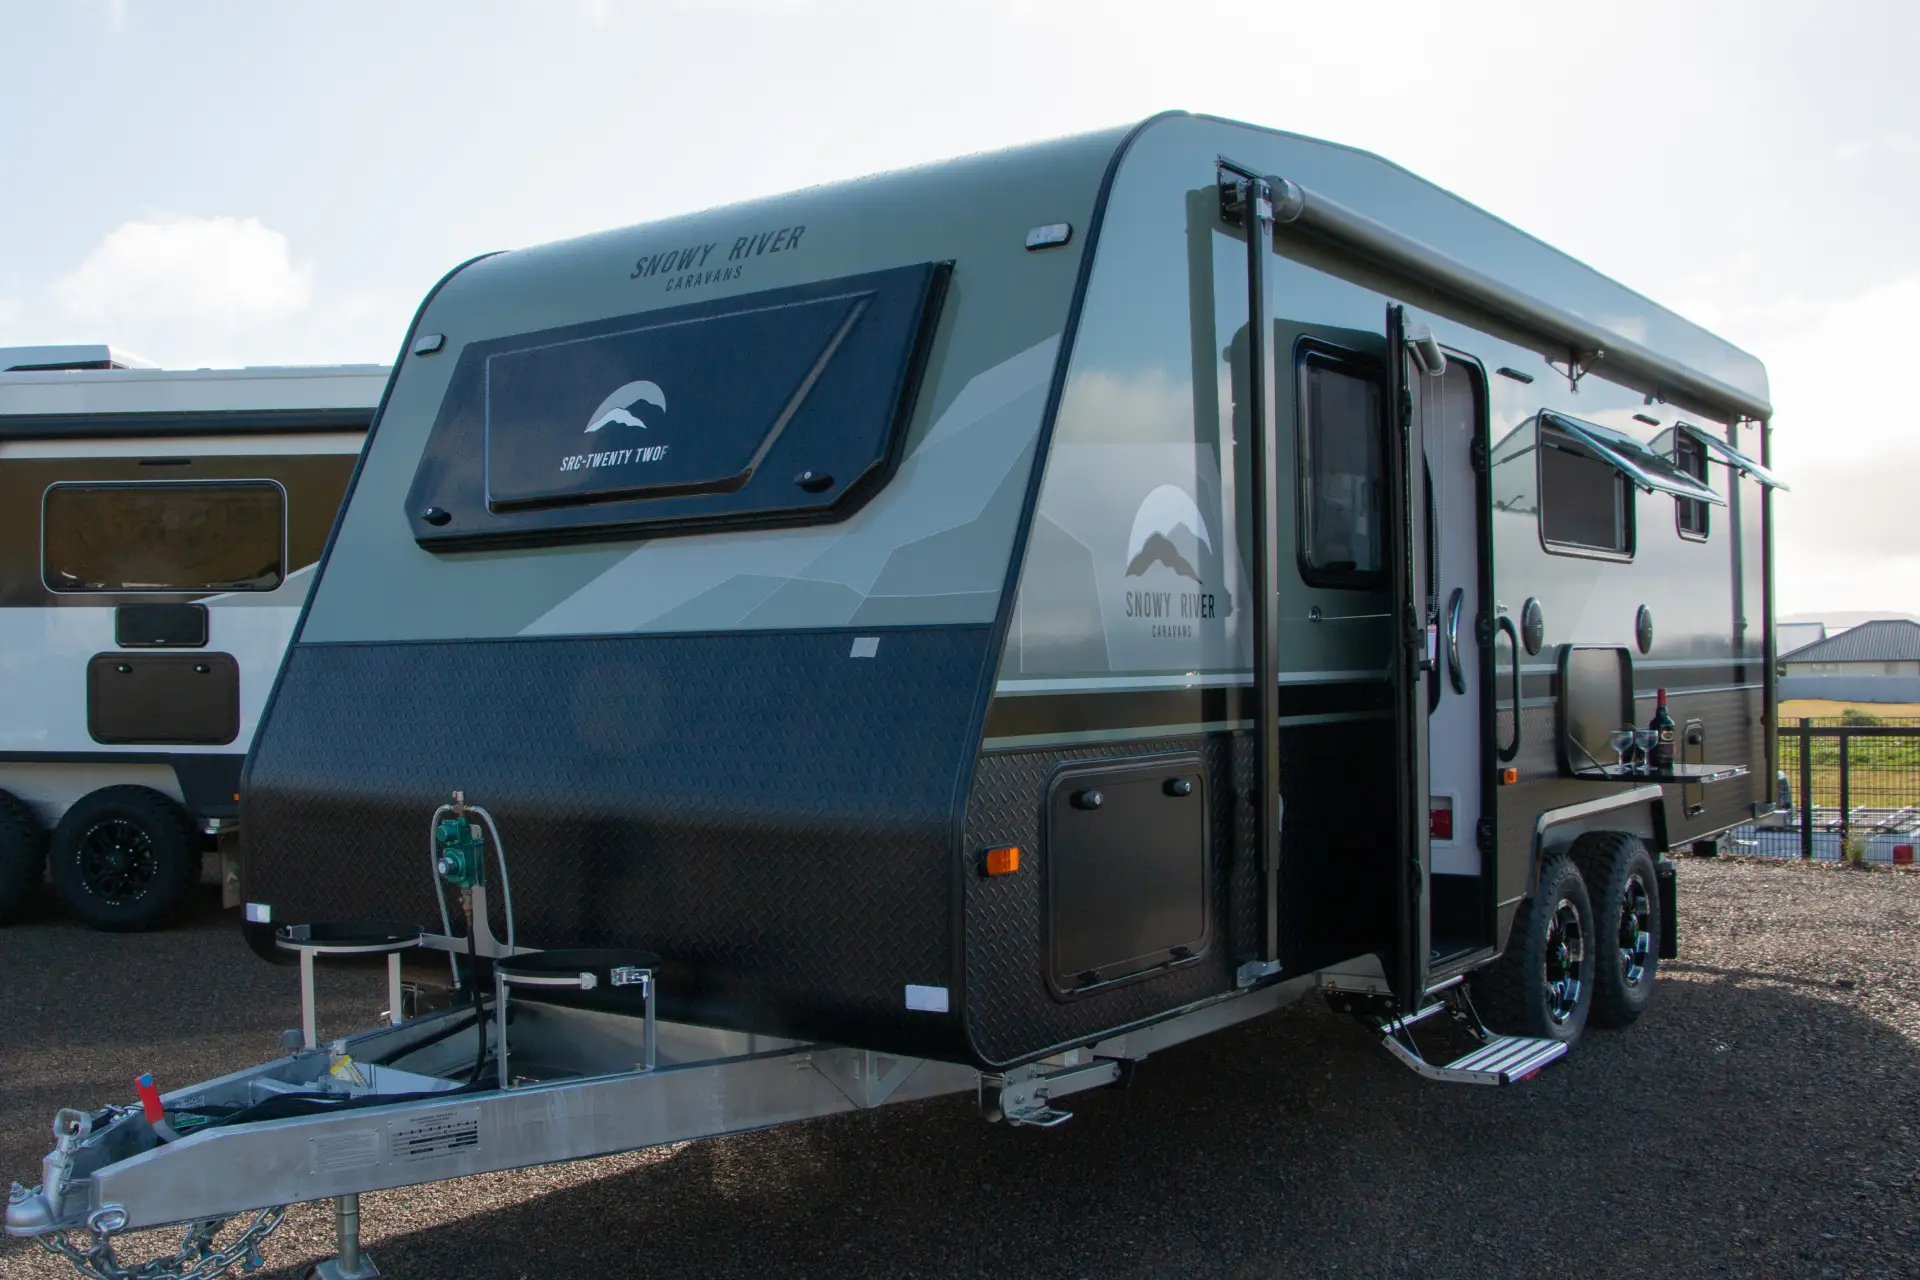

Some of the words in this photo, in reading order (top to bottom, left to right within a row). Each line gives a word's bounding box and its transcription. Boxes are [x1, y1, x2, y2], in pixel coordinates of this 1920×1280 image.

[630, 242, 717, 280] SNOWY
[728, 225, 806, 261] RIVER
[665, 265, 743, 292] CARAVANS
[560, 449, 633, 471] SRC-TWENTY
[1126, 590, 1171, 618] SNOWY
[1181, 592, 1215, 619] RIVER
[1152, 624, 1192, 638] CARAVANS
